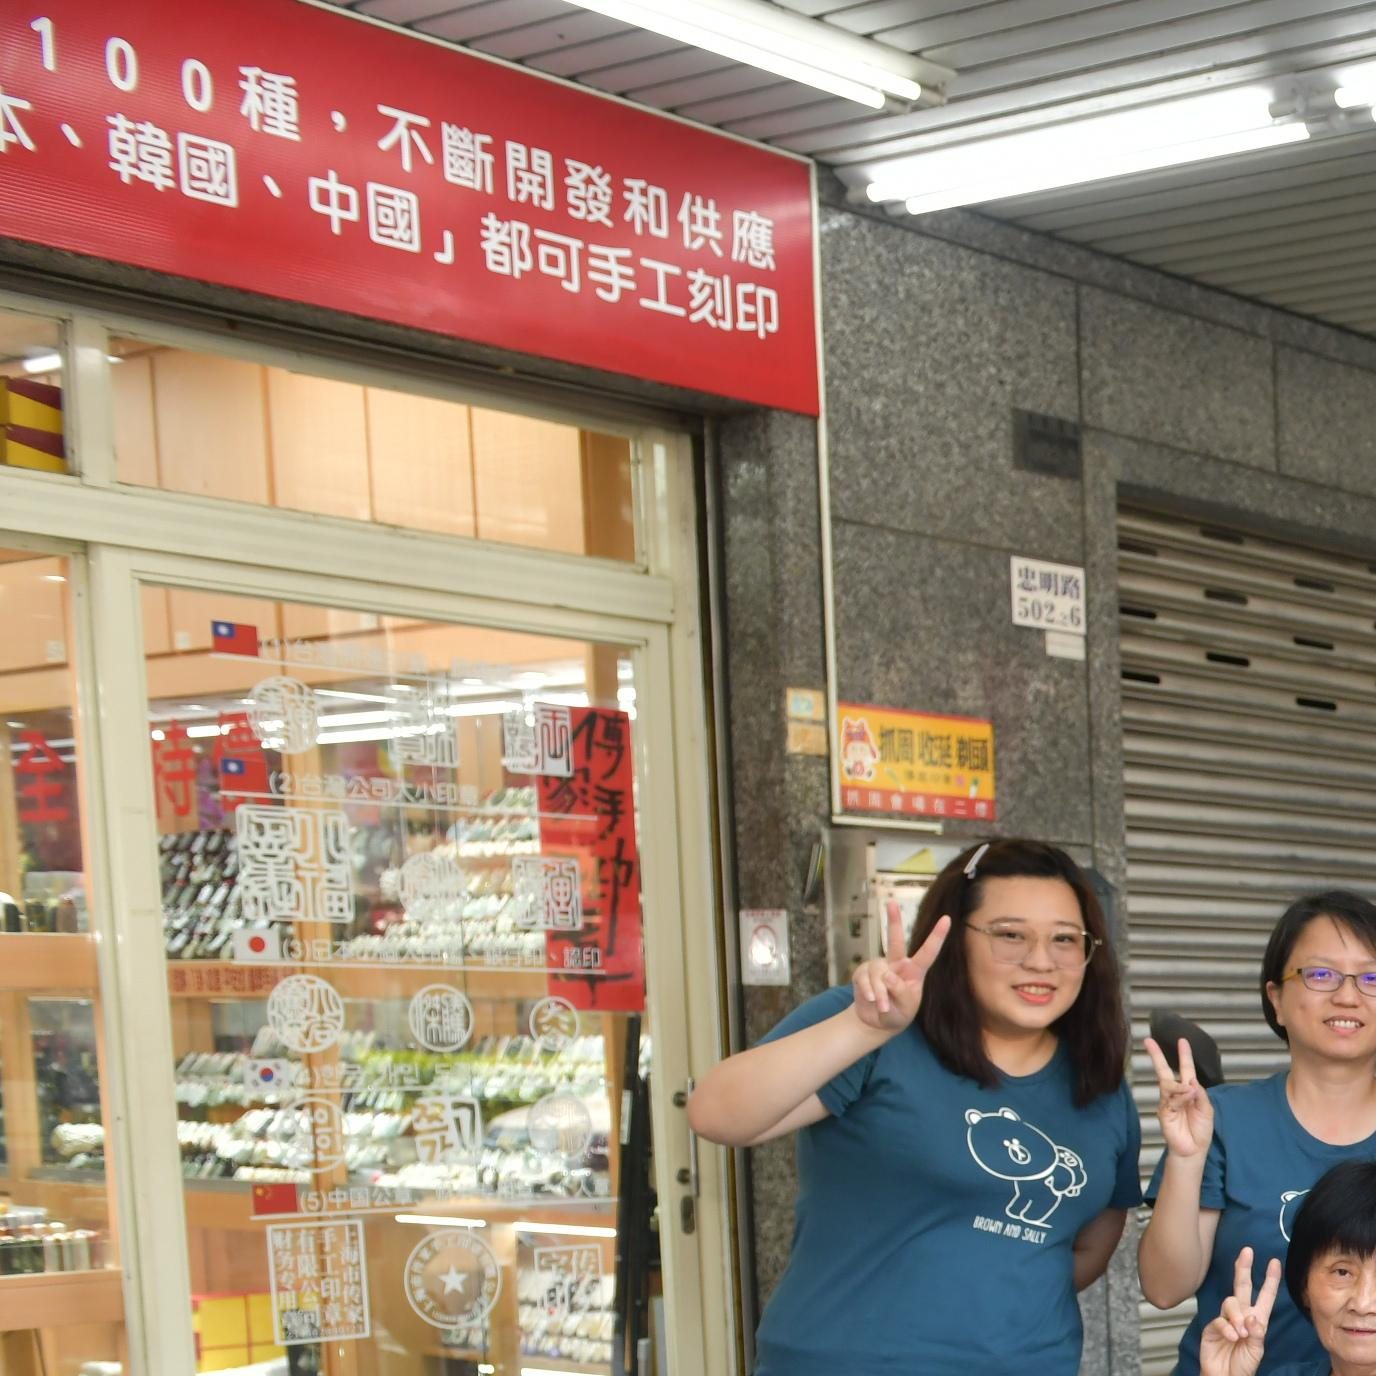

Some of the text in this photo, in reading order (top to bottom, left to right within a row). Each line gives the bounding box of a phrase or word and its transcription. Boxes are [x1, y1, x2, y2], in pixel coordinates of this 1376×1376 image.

[1017, 565, 1081, 600] 忠明路
[973, 1215, 1047, 1245] BROWN AND SALLY
